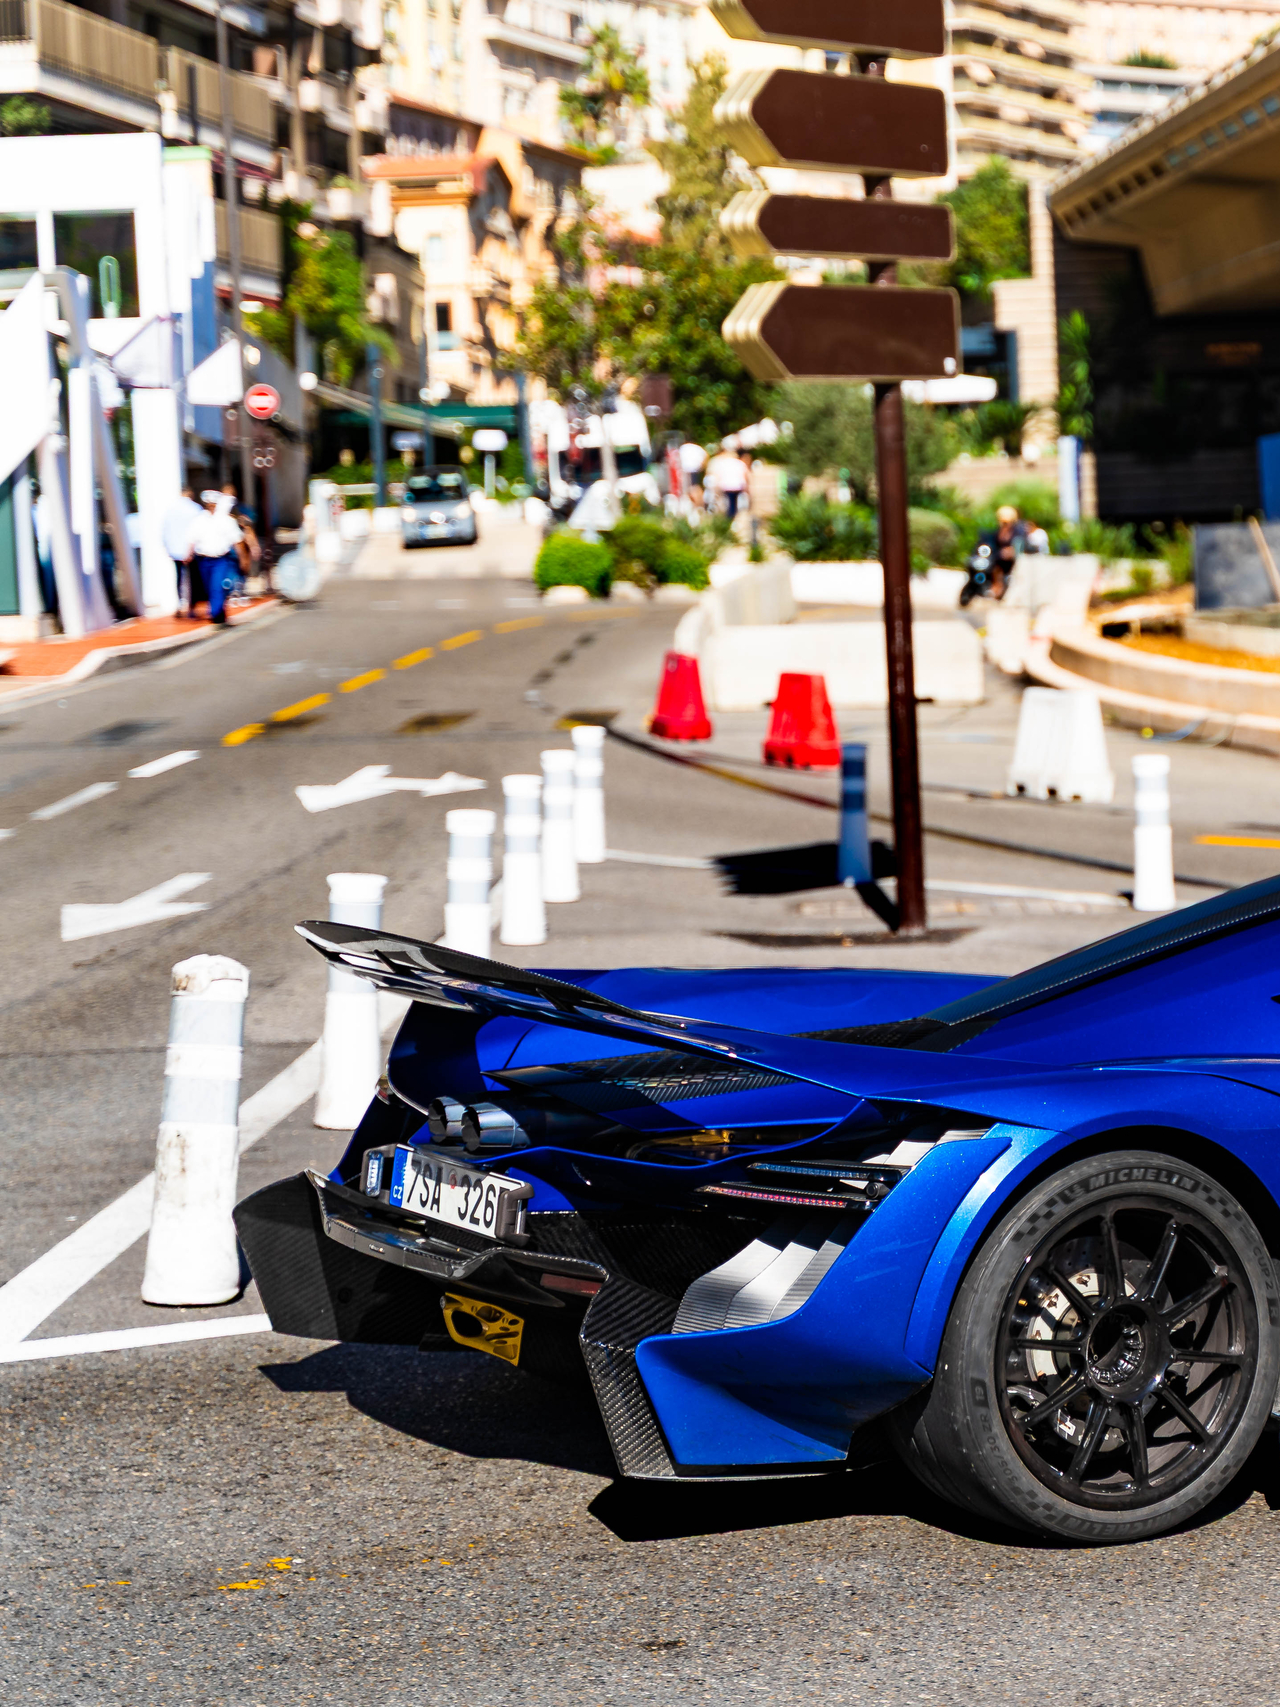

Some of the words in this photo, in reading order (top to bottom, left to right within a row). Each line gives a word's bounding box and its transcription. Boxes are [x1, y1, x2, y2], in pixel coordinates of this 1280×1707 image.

[1088, 1167, 1196, 1191] MICHELIN
[392, 1185, 403, 1200] CZ
[406, 1158, 444, 1214] 7SA
[457, 1174, 511, 1229] 326
[1252, 1246, 1271, 1278] CUP
[1264, 1281, 1274, 1291] 2
[974, 1385, 985, 1401] 19
[979, 1412, 993, 1434] ZR
[986, 1435, 1019, 1483] 305/30
[1063, 1512, 1173, 1536] MICHELIN
